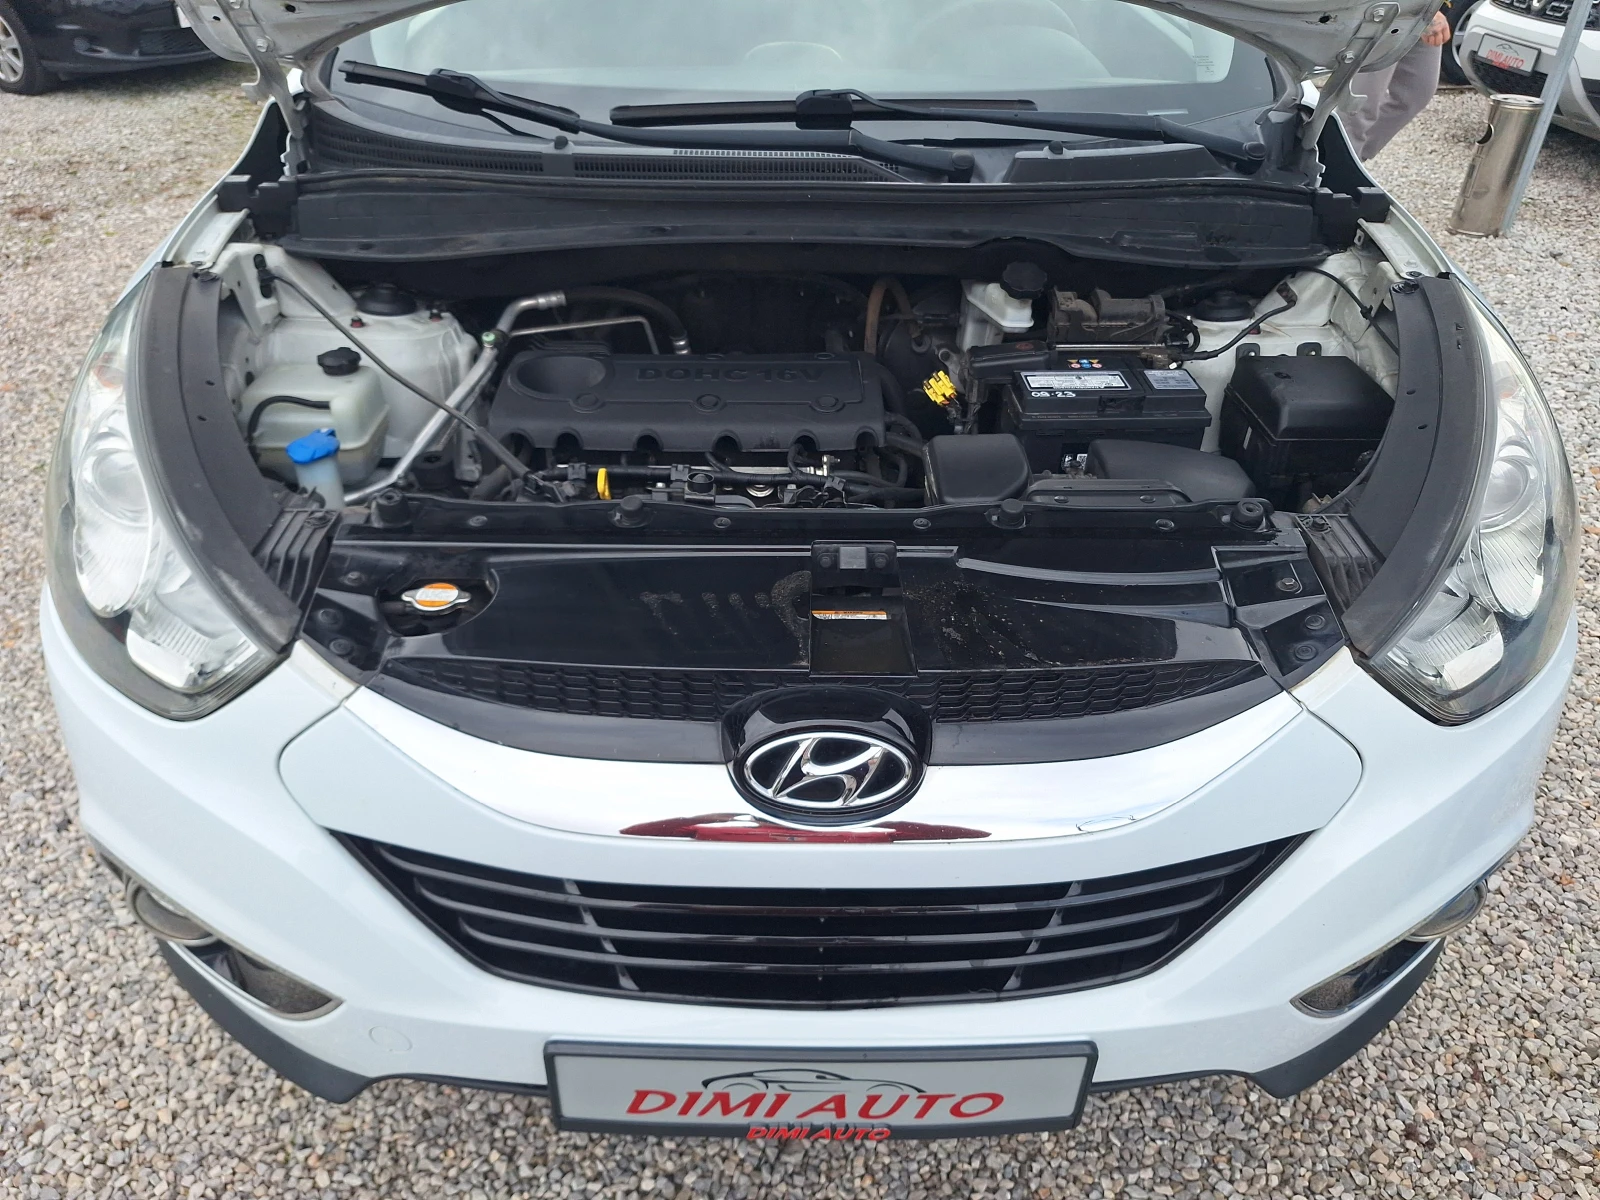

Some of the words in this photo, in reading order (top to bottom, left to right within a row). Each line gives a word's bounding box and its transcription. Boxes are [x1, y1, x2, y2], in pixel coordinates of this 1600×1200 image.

[636, 367, 749, 382] DOHC
[756, 368, 825, 383] 16V
[626, 1090, 789, 1118] DIMI
[797, 1092, 1004, 1120] AUTO
[746, 1126, 810, 1140] DIMI
[810, 1127, 891, 1141] AUTO
